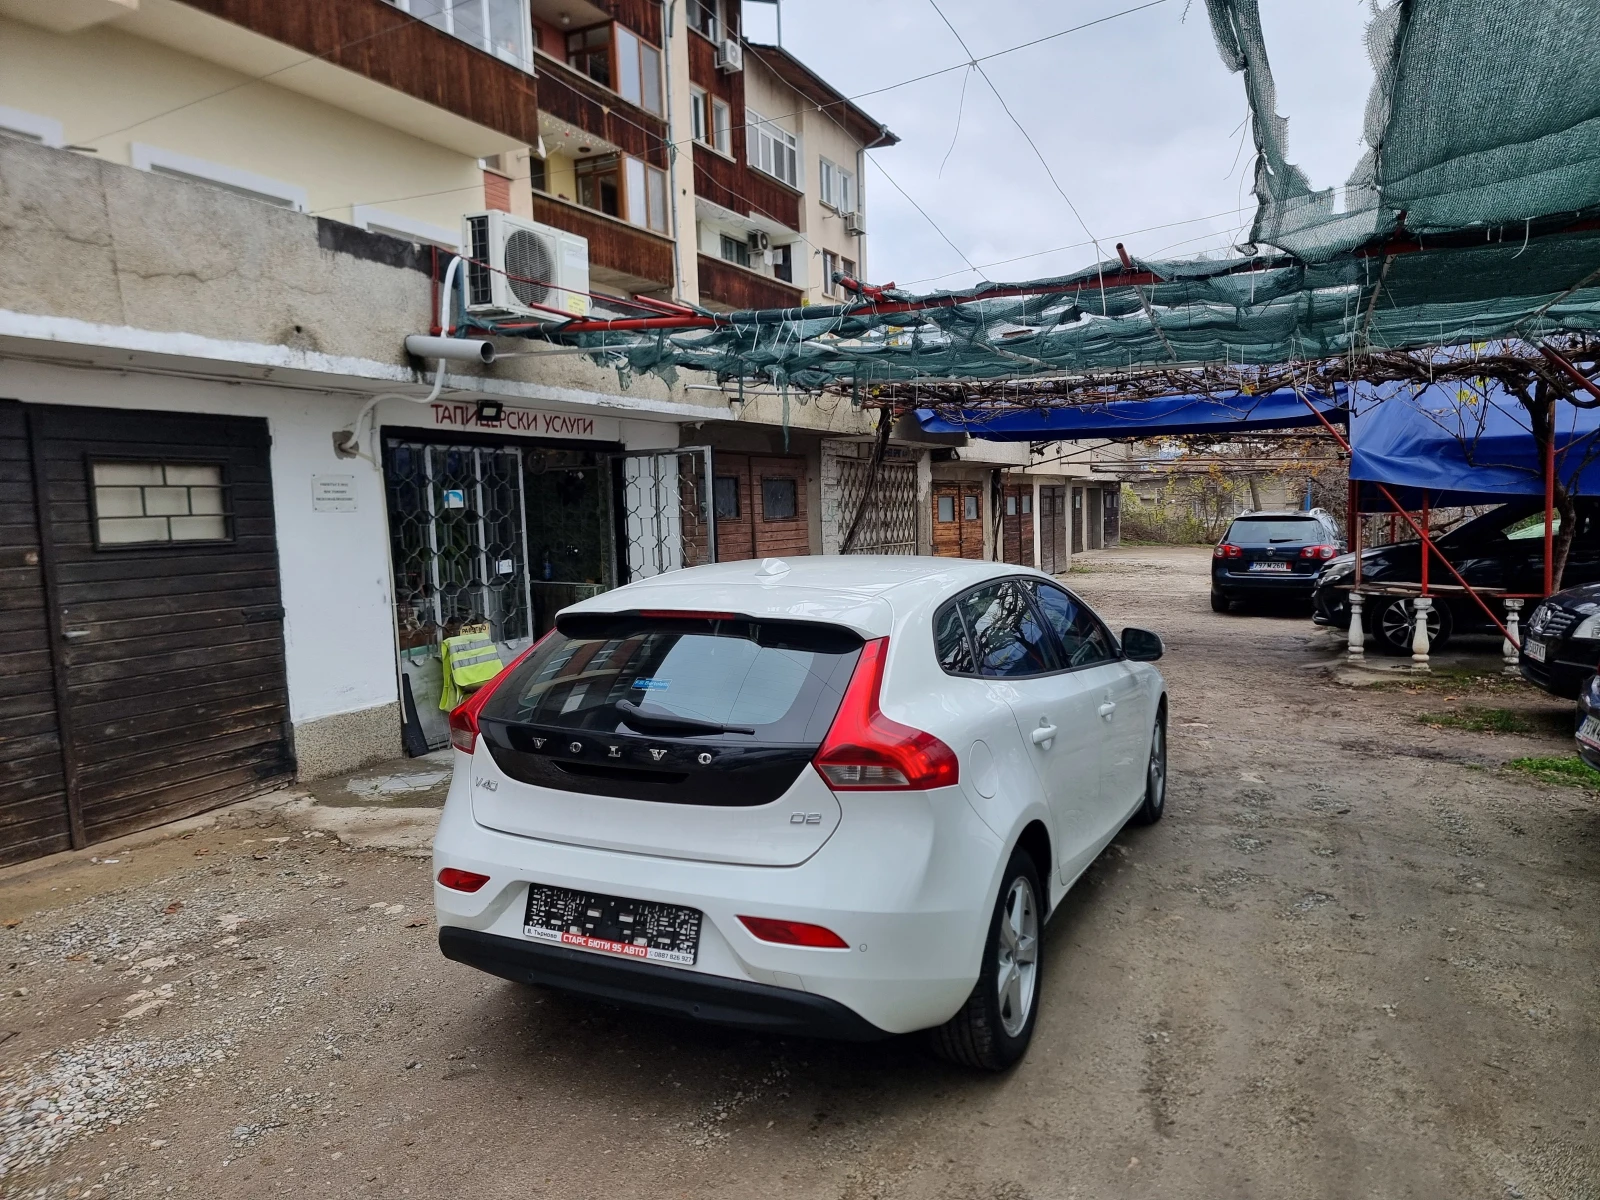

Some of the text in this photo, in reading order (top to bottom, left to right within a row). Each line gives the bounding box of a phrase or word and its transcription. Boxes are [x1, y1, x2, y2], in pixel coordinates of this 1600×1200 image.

[430, 404, 594, 435] ТАПИРСКИ УСЛУГИ
[532, 737, 713, 765] VOLVO
[475, 776, 499, 792] V40
[790, 812, 821, 824] D2
[563, 934, 646, 957] СТАРС БЮТИ 95 АВТО
[681, 955, 692, 963] 927
